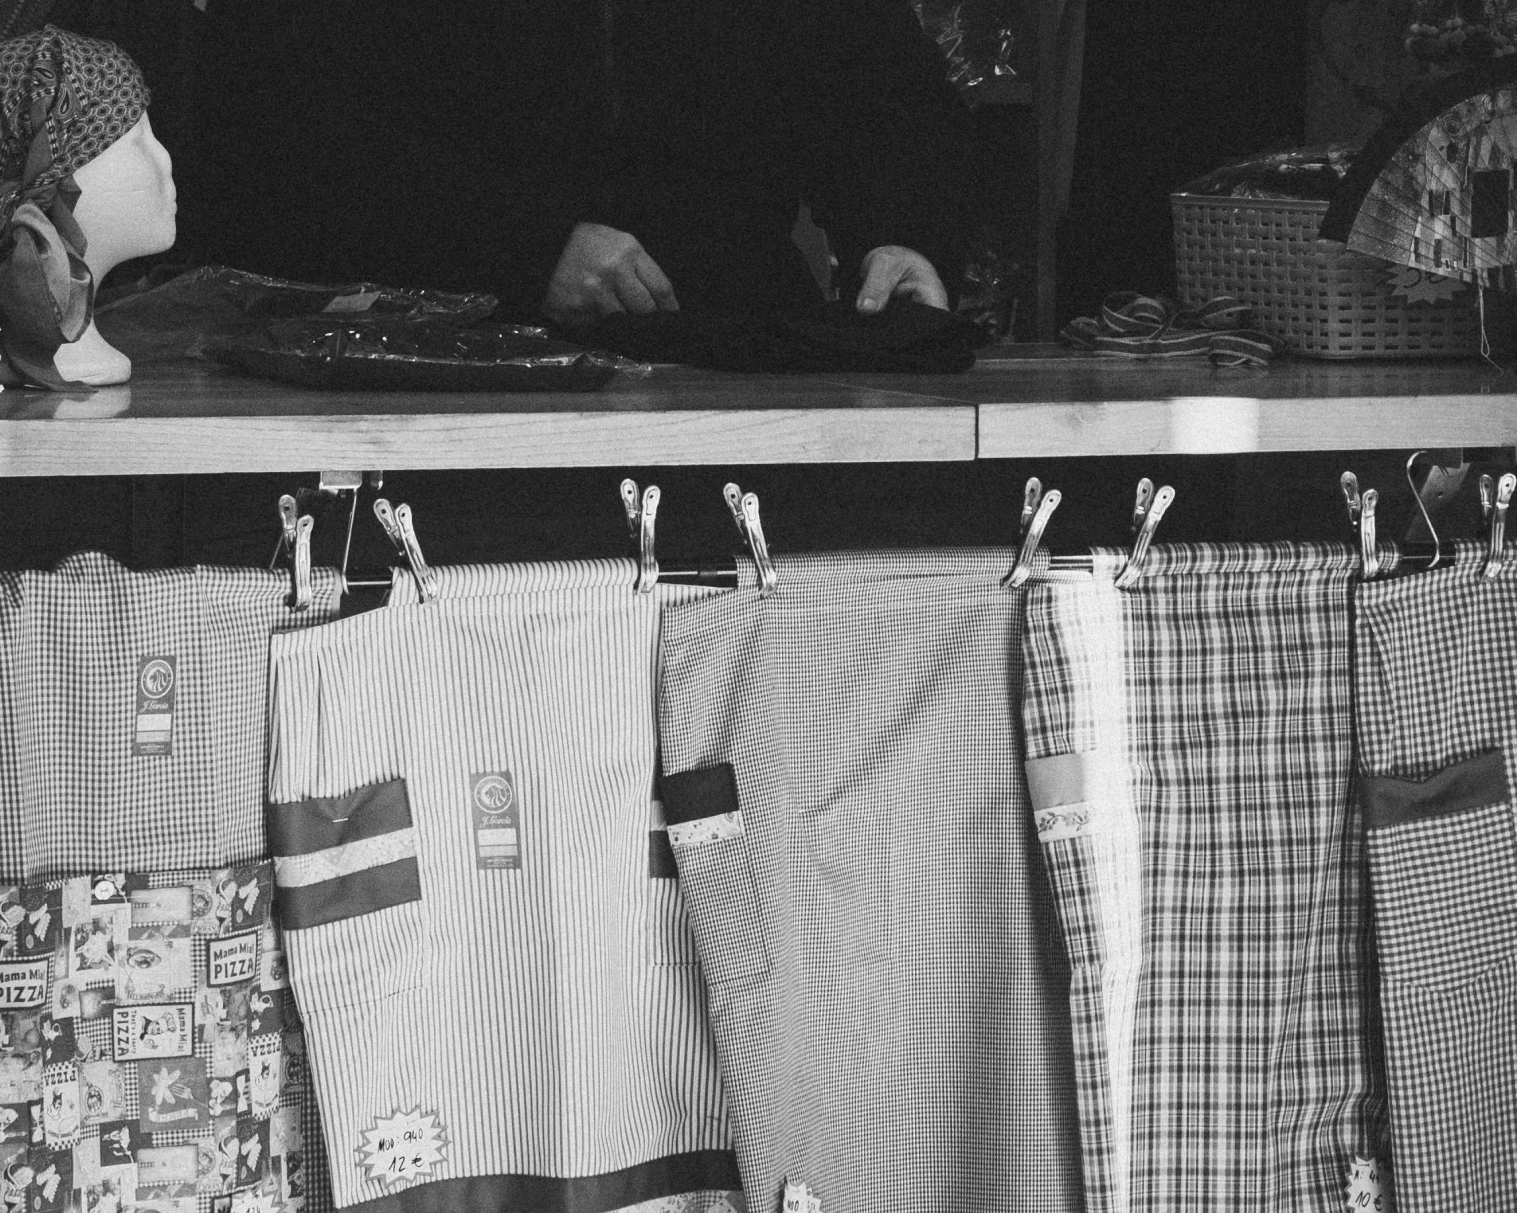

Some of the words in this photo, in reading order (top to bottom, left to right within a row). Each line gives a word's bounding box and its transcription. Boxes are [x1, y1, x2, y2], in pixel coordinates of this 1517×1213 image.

[213, 947, 237, 962] Mama
[214, 957, 254, 979] PIZZA
[176, 1007, 187, 1032] Mama
[117, 1011, 129, 1057] PIZZA
[250, 1042, 281, 1057] PIZZA
[44, 1069, 77, 1086] PIZZA
[403, 1127, 424, 1144] 940
[388, 1156, 406, 1173] 12
[411, 1152, 425, 1168] €
[1355, 1190, 1371, 1208] 10
